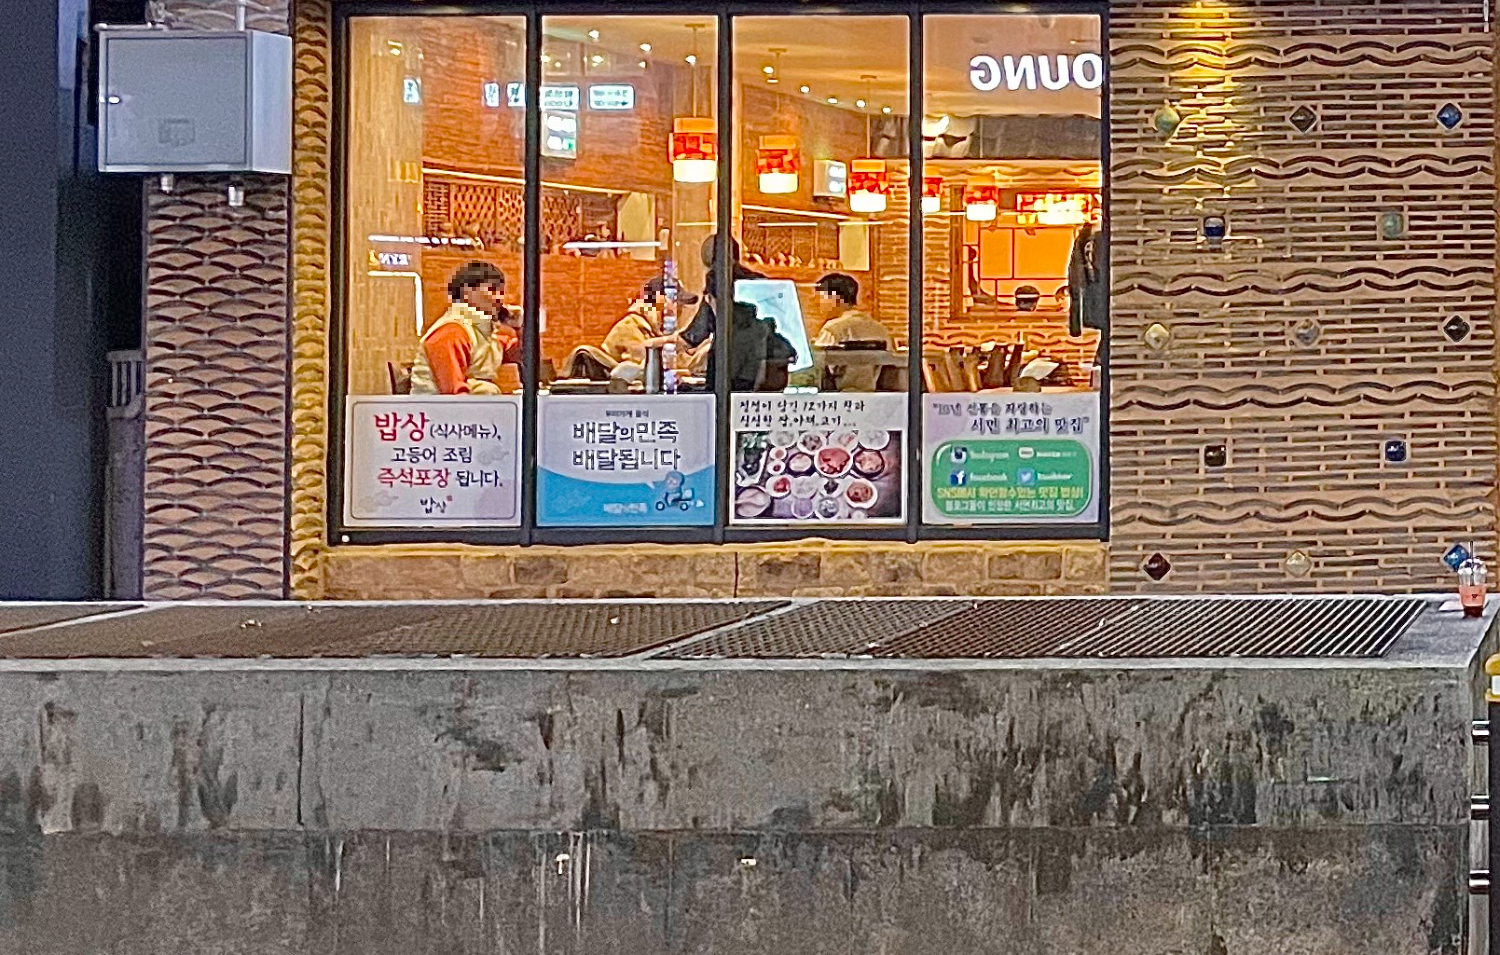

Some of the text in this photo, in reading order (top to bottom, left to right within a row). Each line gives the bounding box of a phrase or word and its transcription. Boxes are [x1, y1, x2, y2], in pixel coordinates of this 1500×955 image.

[572, 421, 680, 444] 배달의민족
[391, 447, 473, 464] 고등어 조림
[572, 448, 681, 471] 배달됩니다
[378, 467, 503, 488] 즉석포장 됩니다.
